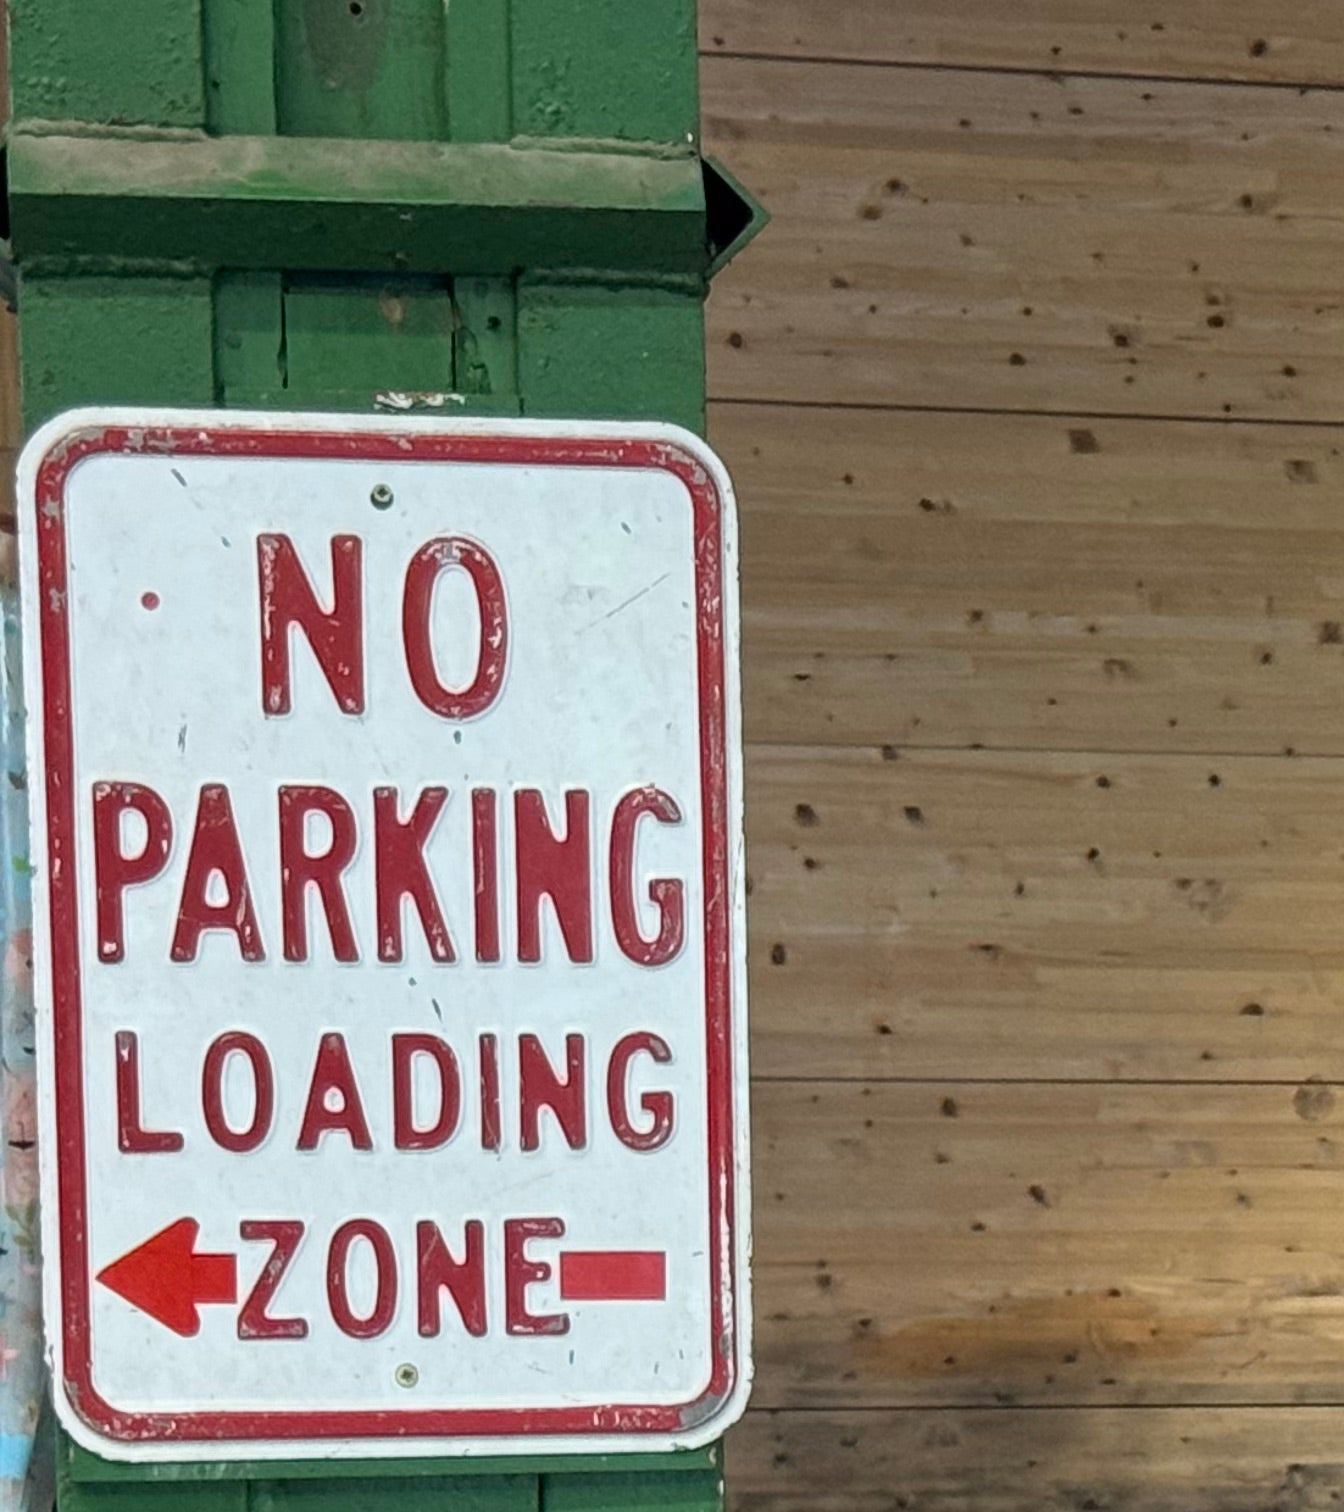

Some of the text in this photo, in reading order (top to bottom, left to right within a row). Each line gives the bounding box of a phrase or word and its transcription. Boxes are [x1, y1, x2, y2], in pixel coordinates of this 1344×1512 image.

[257, 532, 508, 719] NO
[92, 781, 684, 967] PARKING
[114, 1030, 675, 1153] LOADING
[236, 1216, 571, 1340] ZONE
